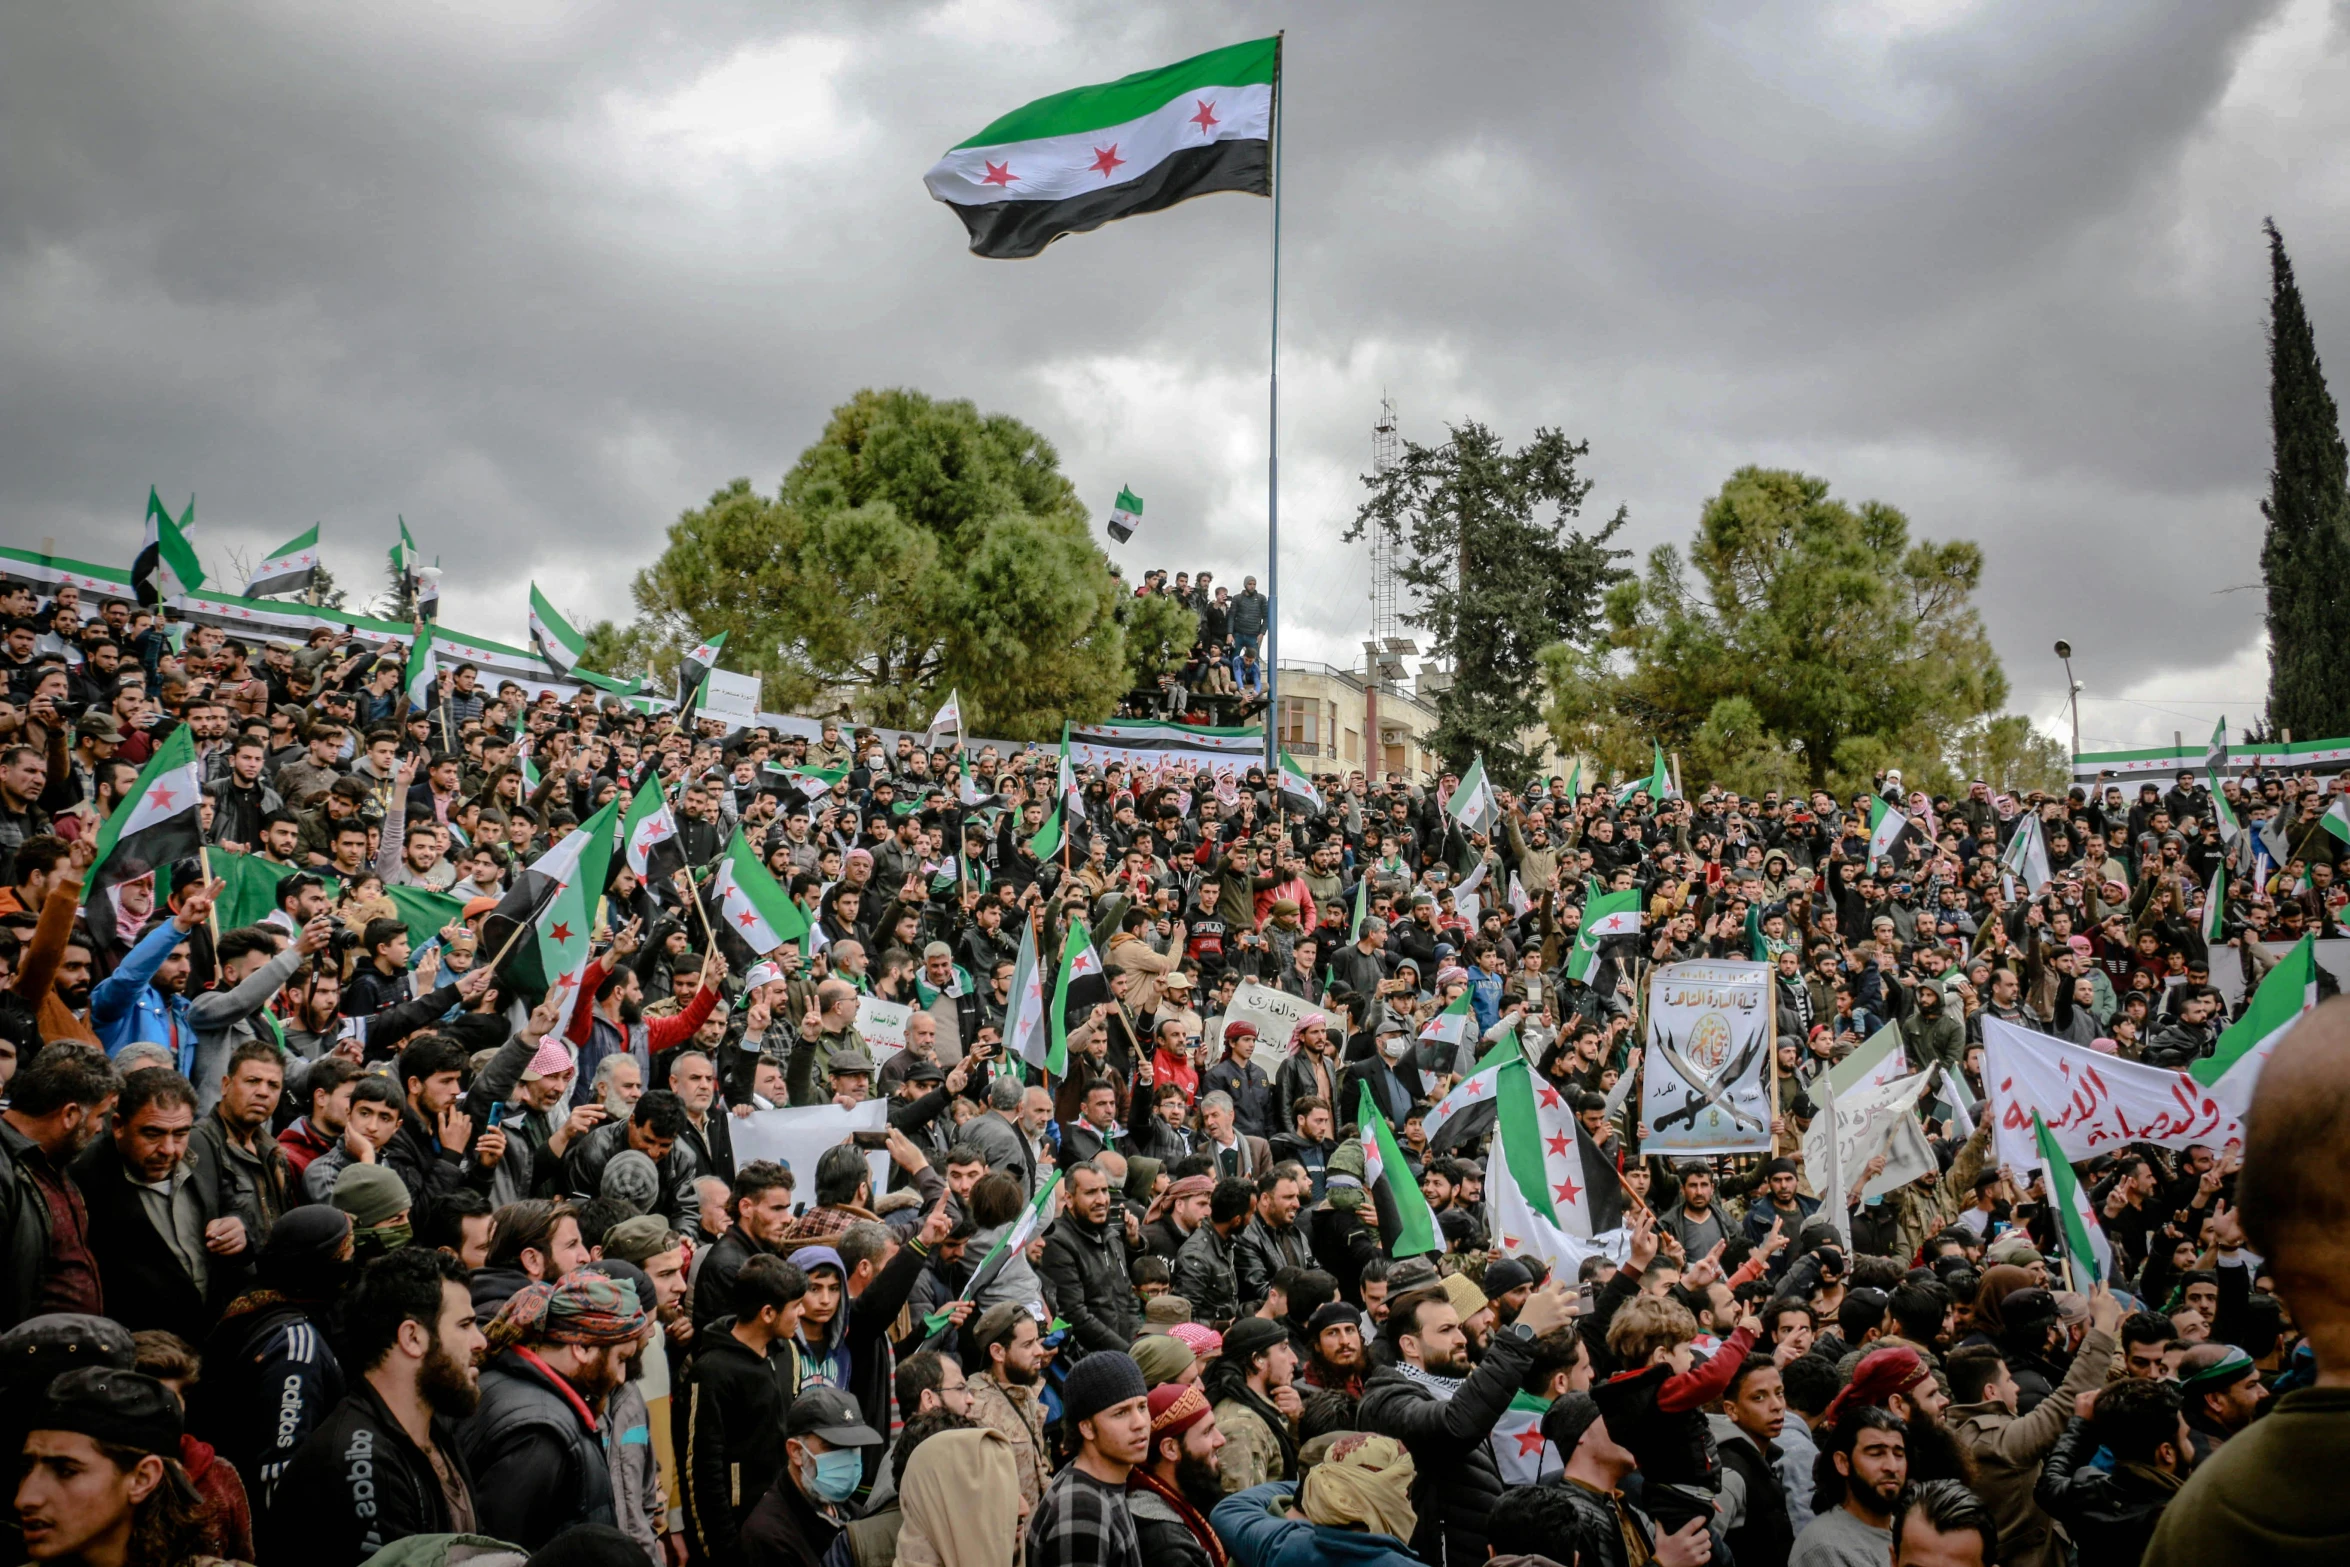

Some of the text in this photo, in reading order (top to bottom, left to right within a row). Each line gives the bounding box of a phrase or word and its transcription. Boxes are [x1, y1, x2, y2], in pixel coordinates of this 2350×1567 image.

[1198, 922, 1222, 932] FILA
[1653, 1082, 1677, 1098] الكرار
[277, 1374, 303, 1448] adidas
